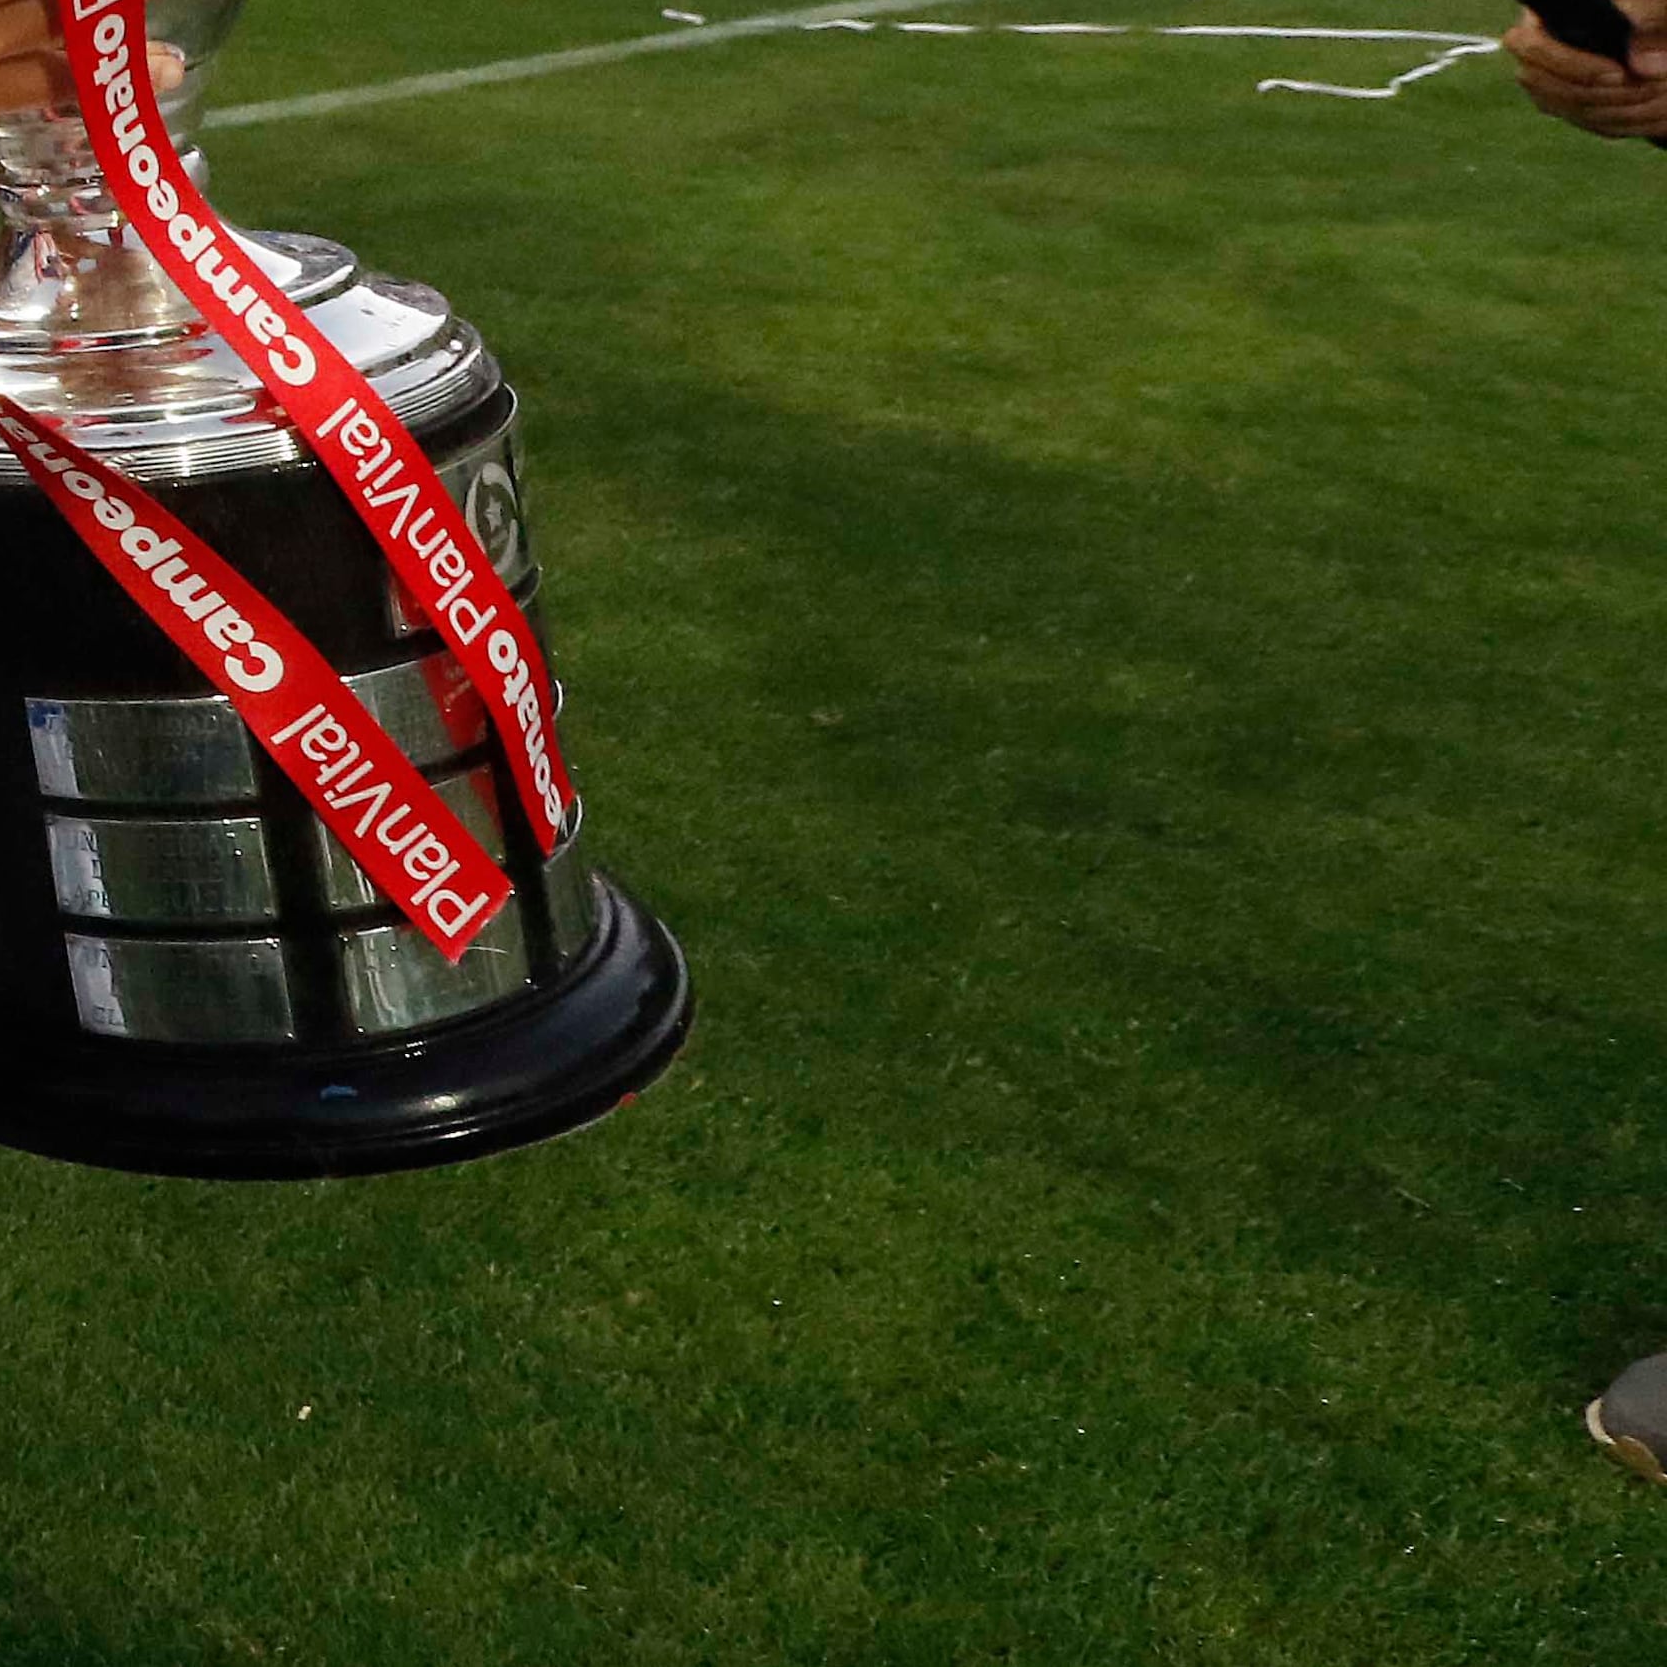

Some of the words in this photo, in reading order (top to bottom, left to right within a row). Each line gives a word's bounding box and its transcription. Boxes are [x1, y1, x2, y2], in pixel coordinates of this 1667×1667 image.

[91, 11, 318, 387] Campeonato
[315, 396, 497, 647] PlanVital
[269, 702, 493, 940] PlanVital
